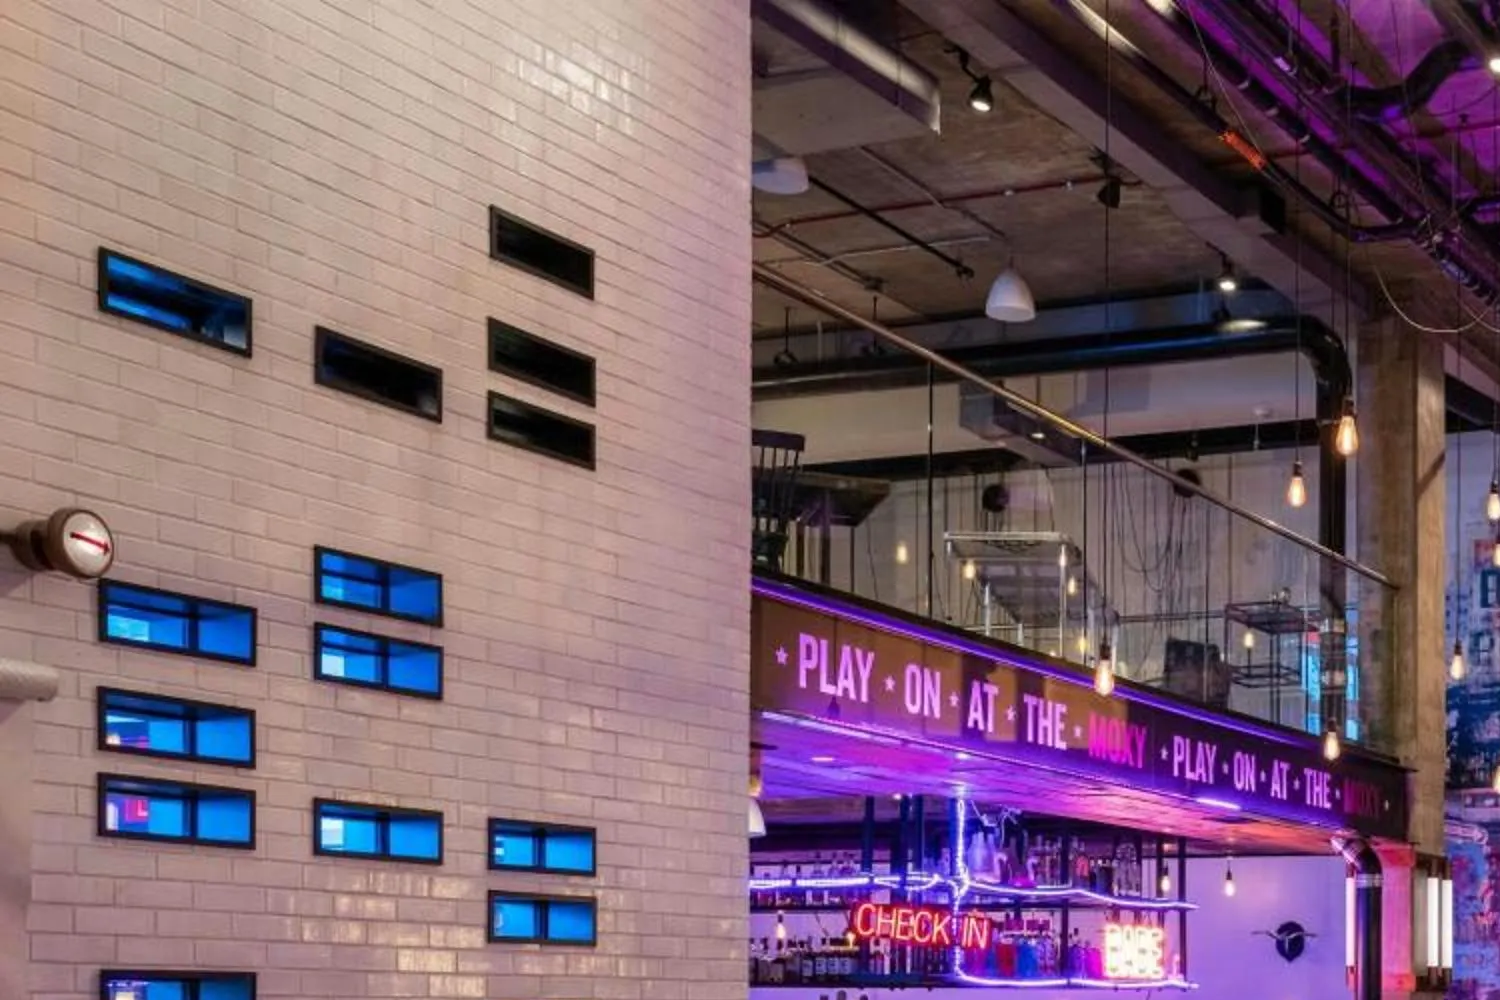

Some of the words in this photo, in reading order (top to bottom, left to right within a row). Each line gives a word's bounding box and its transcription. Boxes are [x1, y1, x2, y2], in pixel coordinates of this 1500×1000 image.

[799, 632, 875, 704] PLAY
[904, 663, 942, 719] ON
[966, 679, 999, 733] AT
[1023, 693, 1068, 750] THE
[1088, 713, 1147, 768] MOXY
[1172, 735, 1218, 785] PLAY
[1233, 751, 1257, 793] ON
[1270, 759, 1292, 801] AT
[1303, 767, 1333, 809] THE
[856, 903, 951, 945] CHECK
[961, 915, 989, 949] IN
